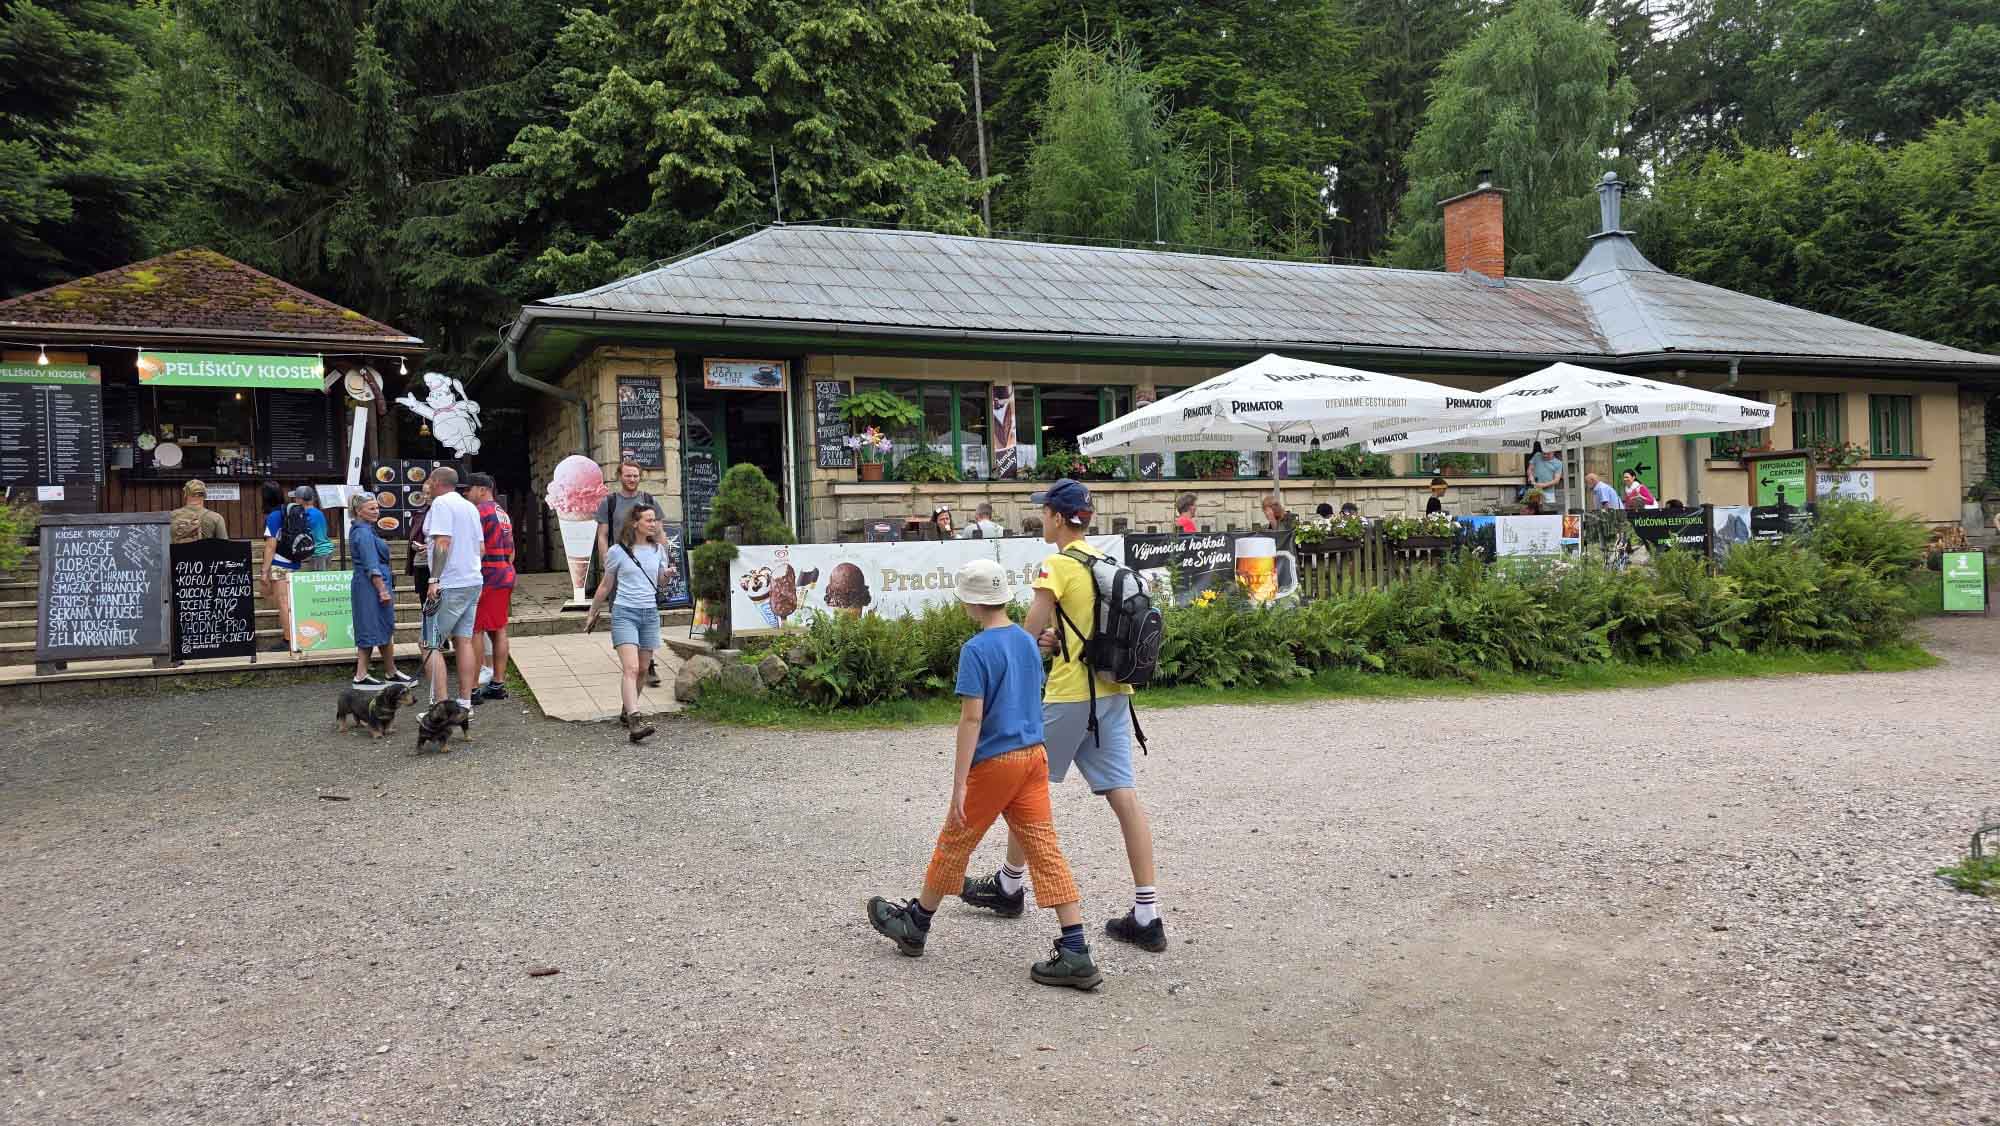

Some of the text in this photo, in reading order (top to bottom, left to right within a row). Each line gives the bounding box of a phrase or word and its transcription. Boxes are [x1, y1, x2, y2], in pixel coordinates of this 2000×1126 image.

[258, 363, 323, 379] KIOSEK
[1232, 400, 1284, 418] PRIMATOR
[1447, 397, 1493, 409] PRIMATOR
[1183, 404, 1213, 420] PRIMATOR
[1541, 407, 1588, 422] PRIMATOR
[1605, 403, 1640, 417] PRIMATOR
[1740, 405, 1770, 417] PRIMATOR
[1373, 431, 1408, 446] PRIMATOR
[1770, 469, 1804, 477] CENTRUM
[55, 530, 83, 540] KIOSEK
[1676, 535, 1705, 543] PRACHOV
[55, 538, 114, 556] LANGOŠE
[178, 561, 203, 574] PIVO
[1183, 557, 1194, 567] ze
[178, 574, 213, 586] KOFOLA
[101, 582, 152, 594] HRANOLKY
[217, 585, 251, 597] NEALKO
[50, 594, 91, 608] STRIPSY
[96, 593, 140, 606] HRANOLKY
[213, 598, 239, 610] PIVO
[95, 607, 103, 619] V
[105, 606, 144, 619] HOUSCE
[72, 620, 78, 631] V
[80, 619, 120, 632] HOUSCE
[225, 618, 247, 632] PRO
